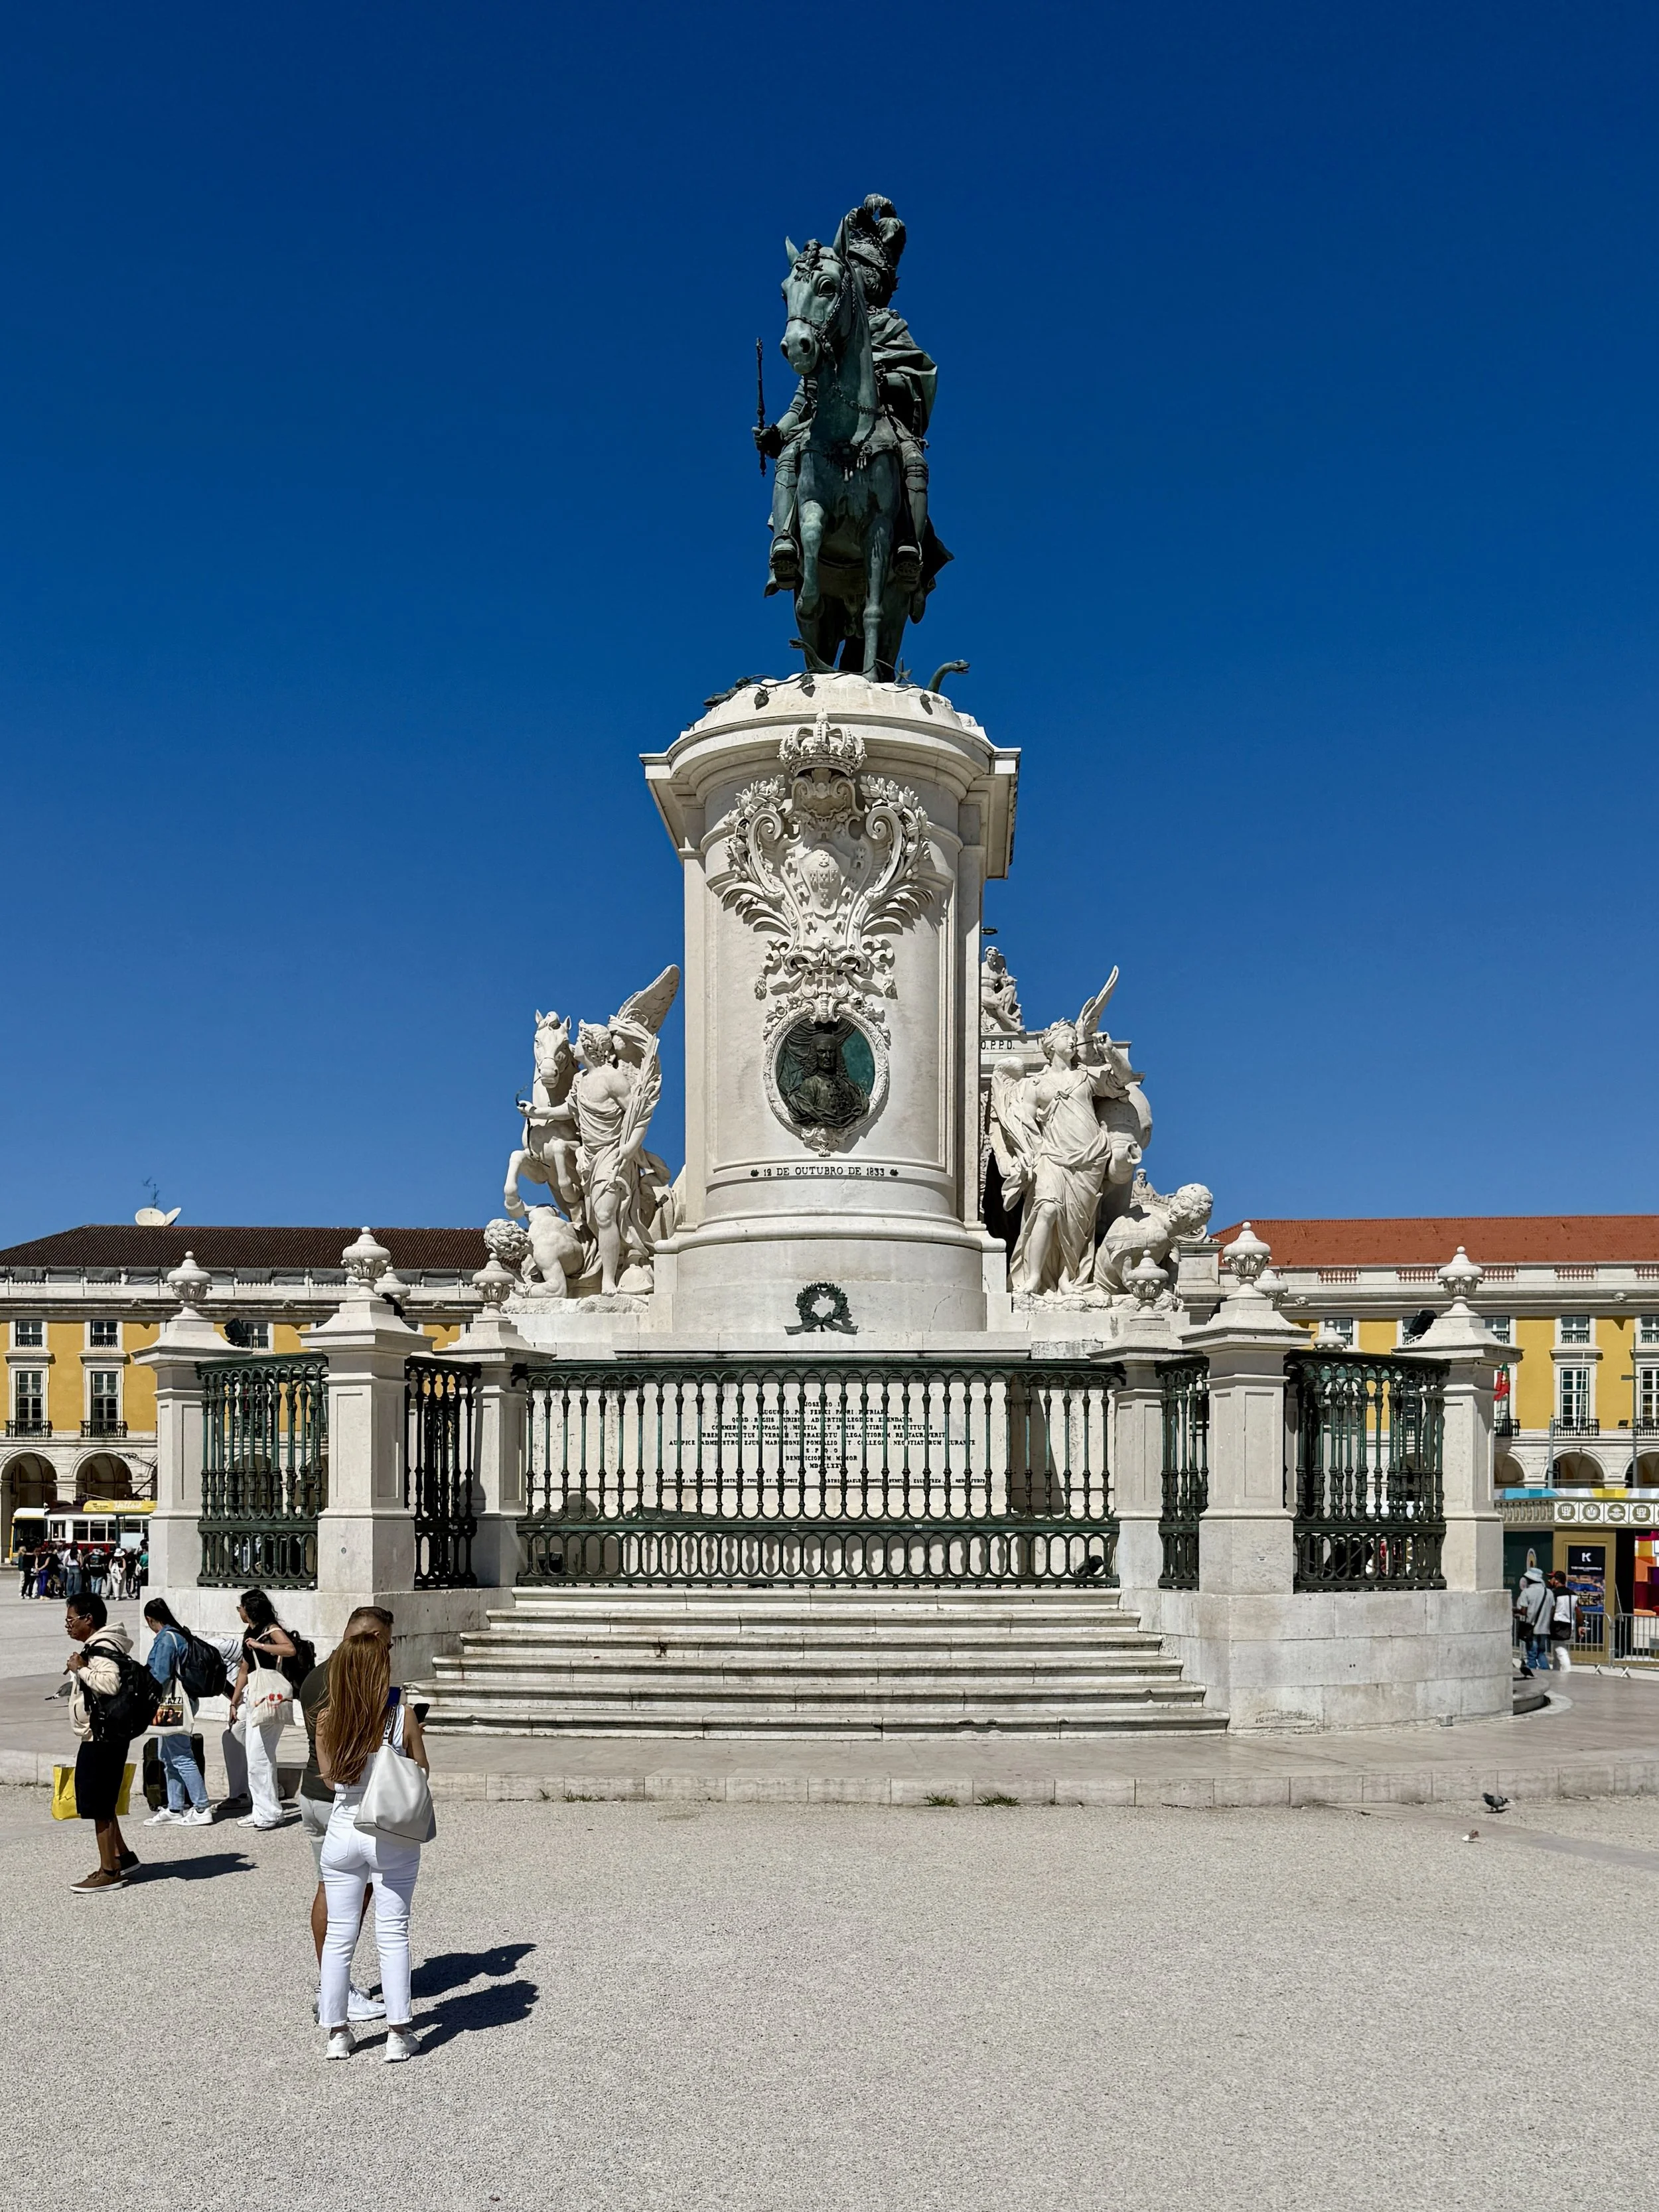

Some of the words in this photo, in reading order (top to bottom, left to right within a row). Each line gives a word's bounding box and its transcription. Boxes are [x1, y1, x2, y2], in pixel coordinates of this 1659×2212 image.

[795, 1166, 843, 1175] OUTUBRO
[867, 1168, 885, 1176] 1833
[1581, 1553, 1592, 1562] K
